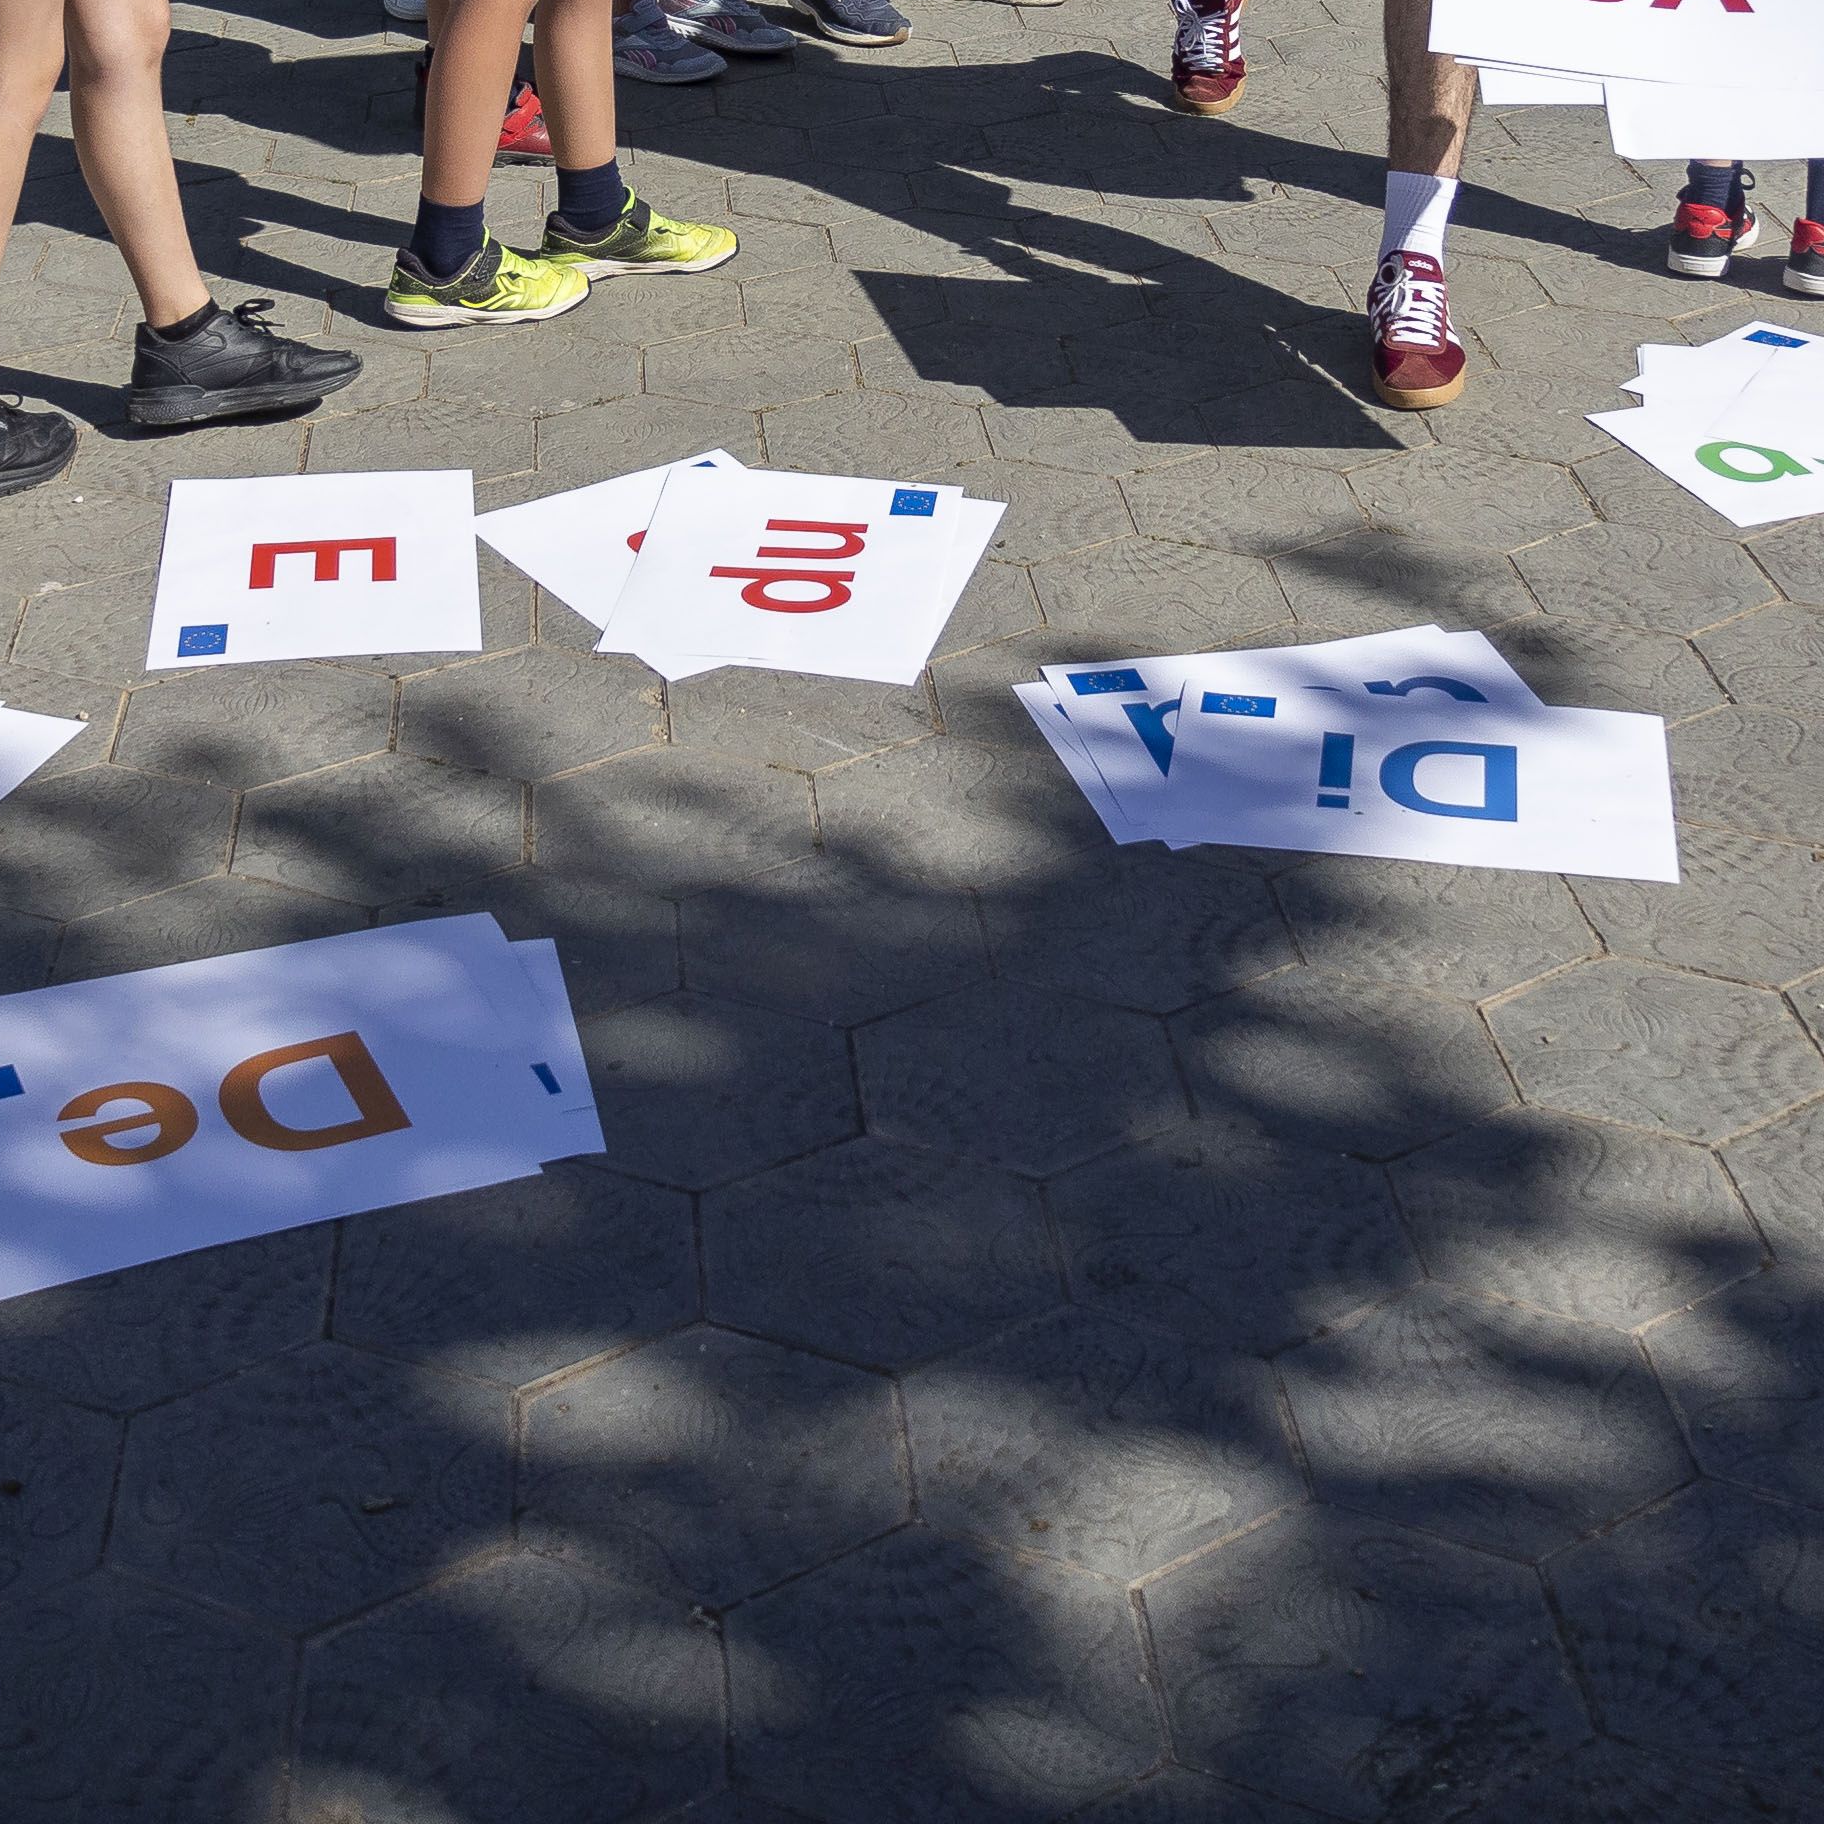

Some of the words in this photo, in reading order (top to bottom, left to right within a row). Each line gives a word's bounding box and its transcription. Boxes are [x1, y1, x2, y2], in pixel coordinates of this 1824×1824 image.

[248, 536, 397, 590] E
[1316, 731, 1518, 823] Di
[54, 1030, 413, 1167] De
